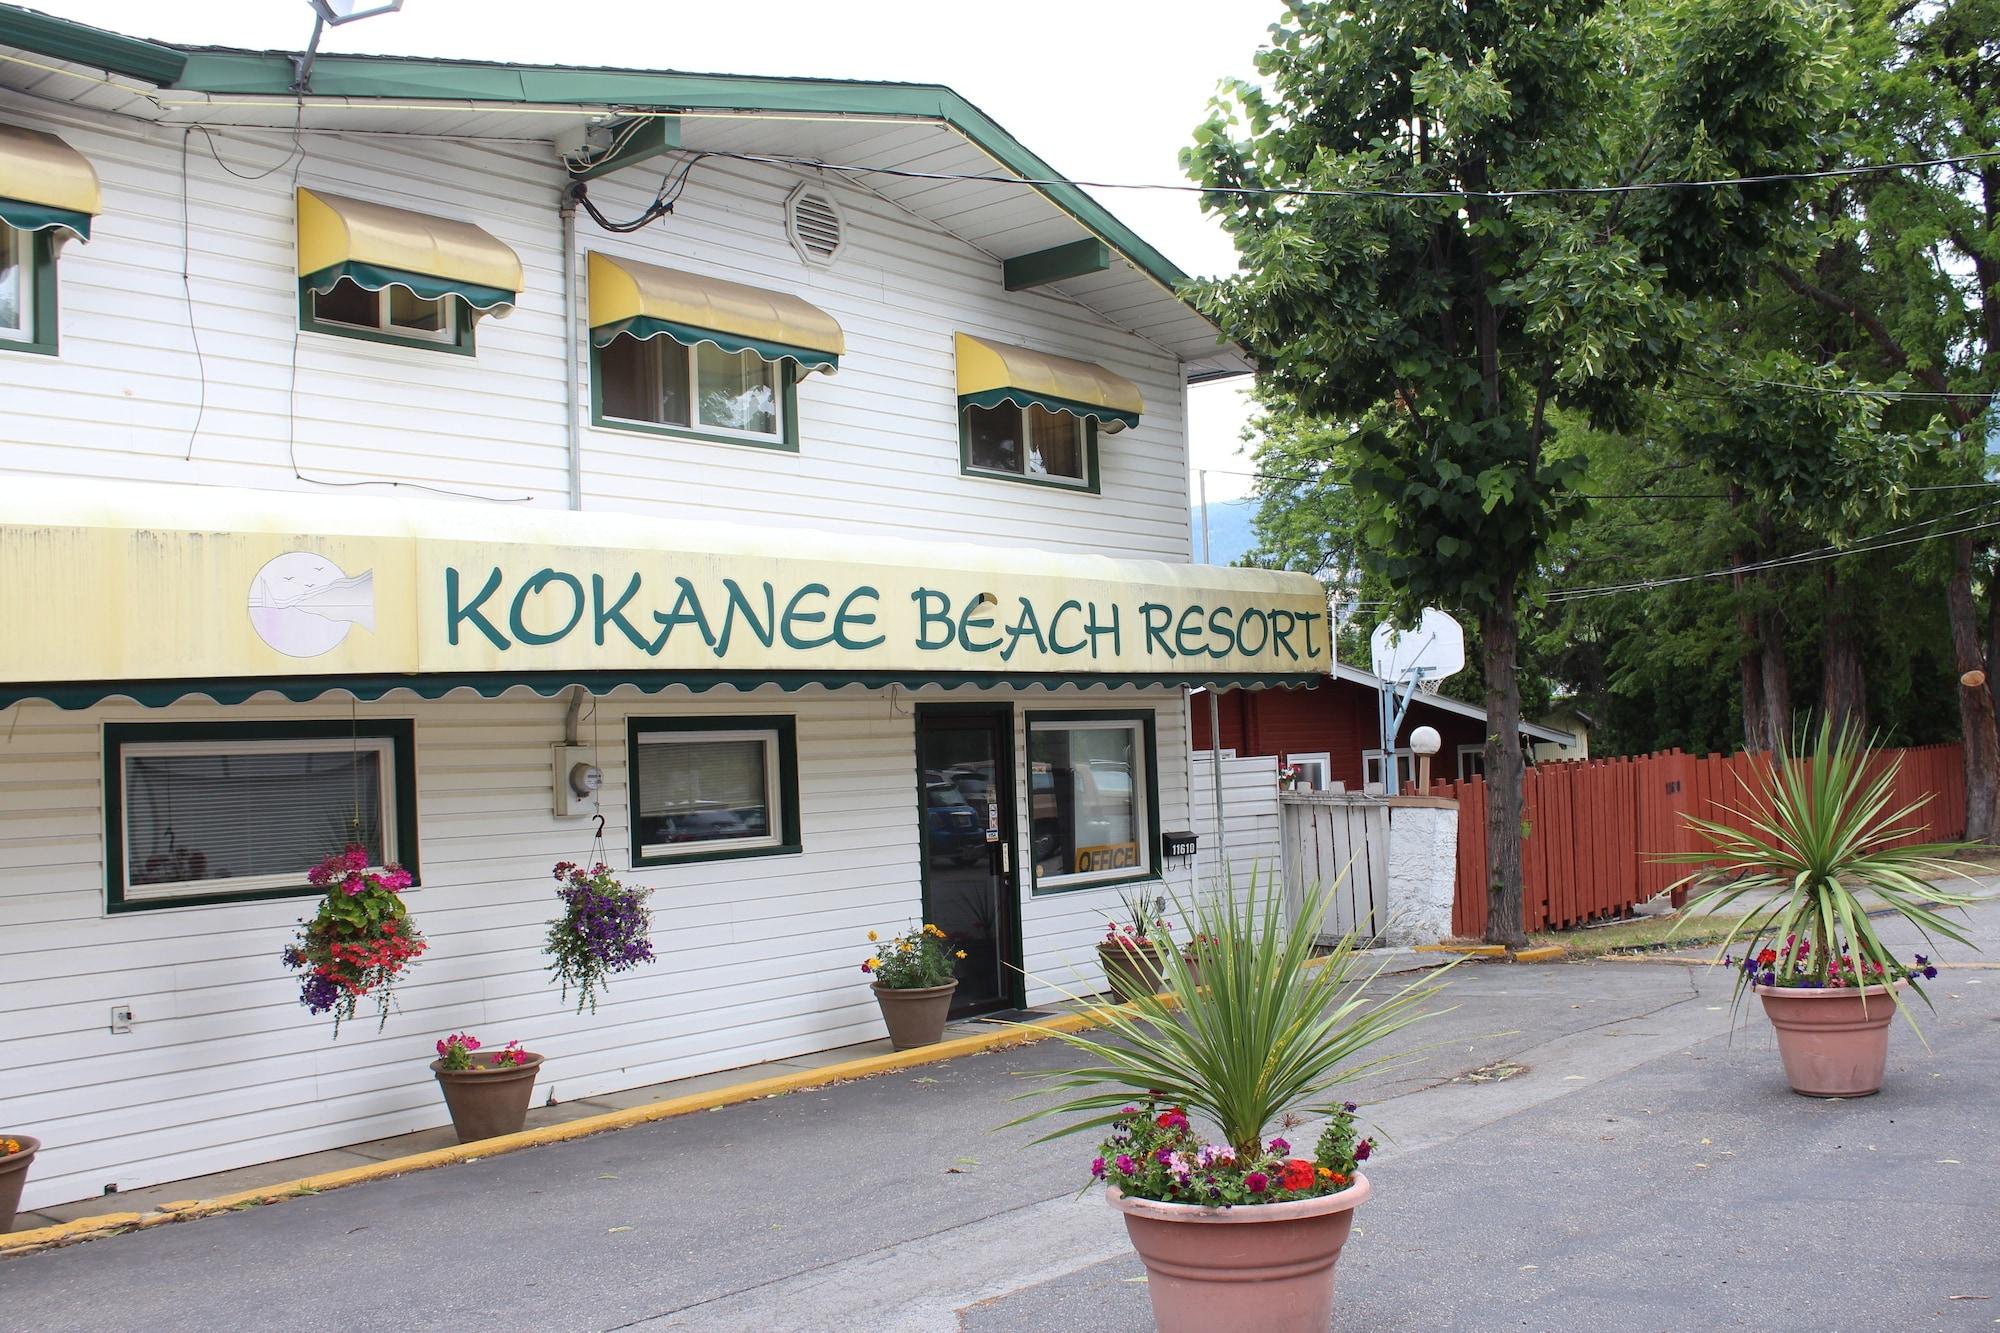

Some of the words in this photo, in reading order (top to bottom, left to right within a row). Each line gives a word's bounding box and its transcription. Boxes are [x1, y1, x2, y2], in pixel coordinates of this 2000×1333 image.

[446, 567, 886, 658] KOKANEE
[911, 587, 1121, 661] BEACH
[1139, 602, 1322, 662] RESORT
[1079, 847, 1137, 872] OFFICE
[1171, 842, 1195, 856] 11610
